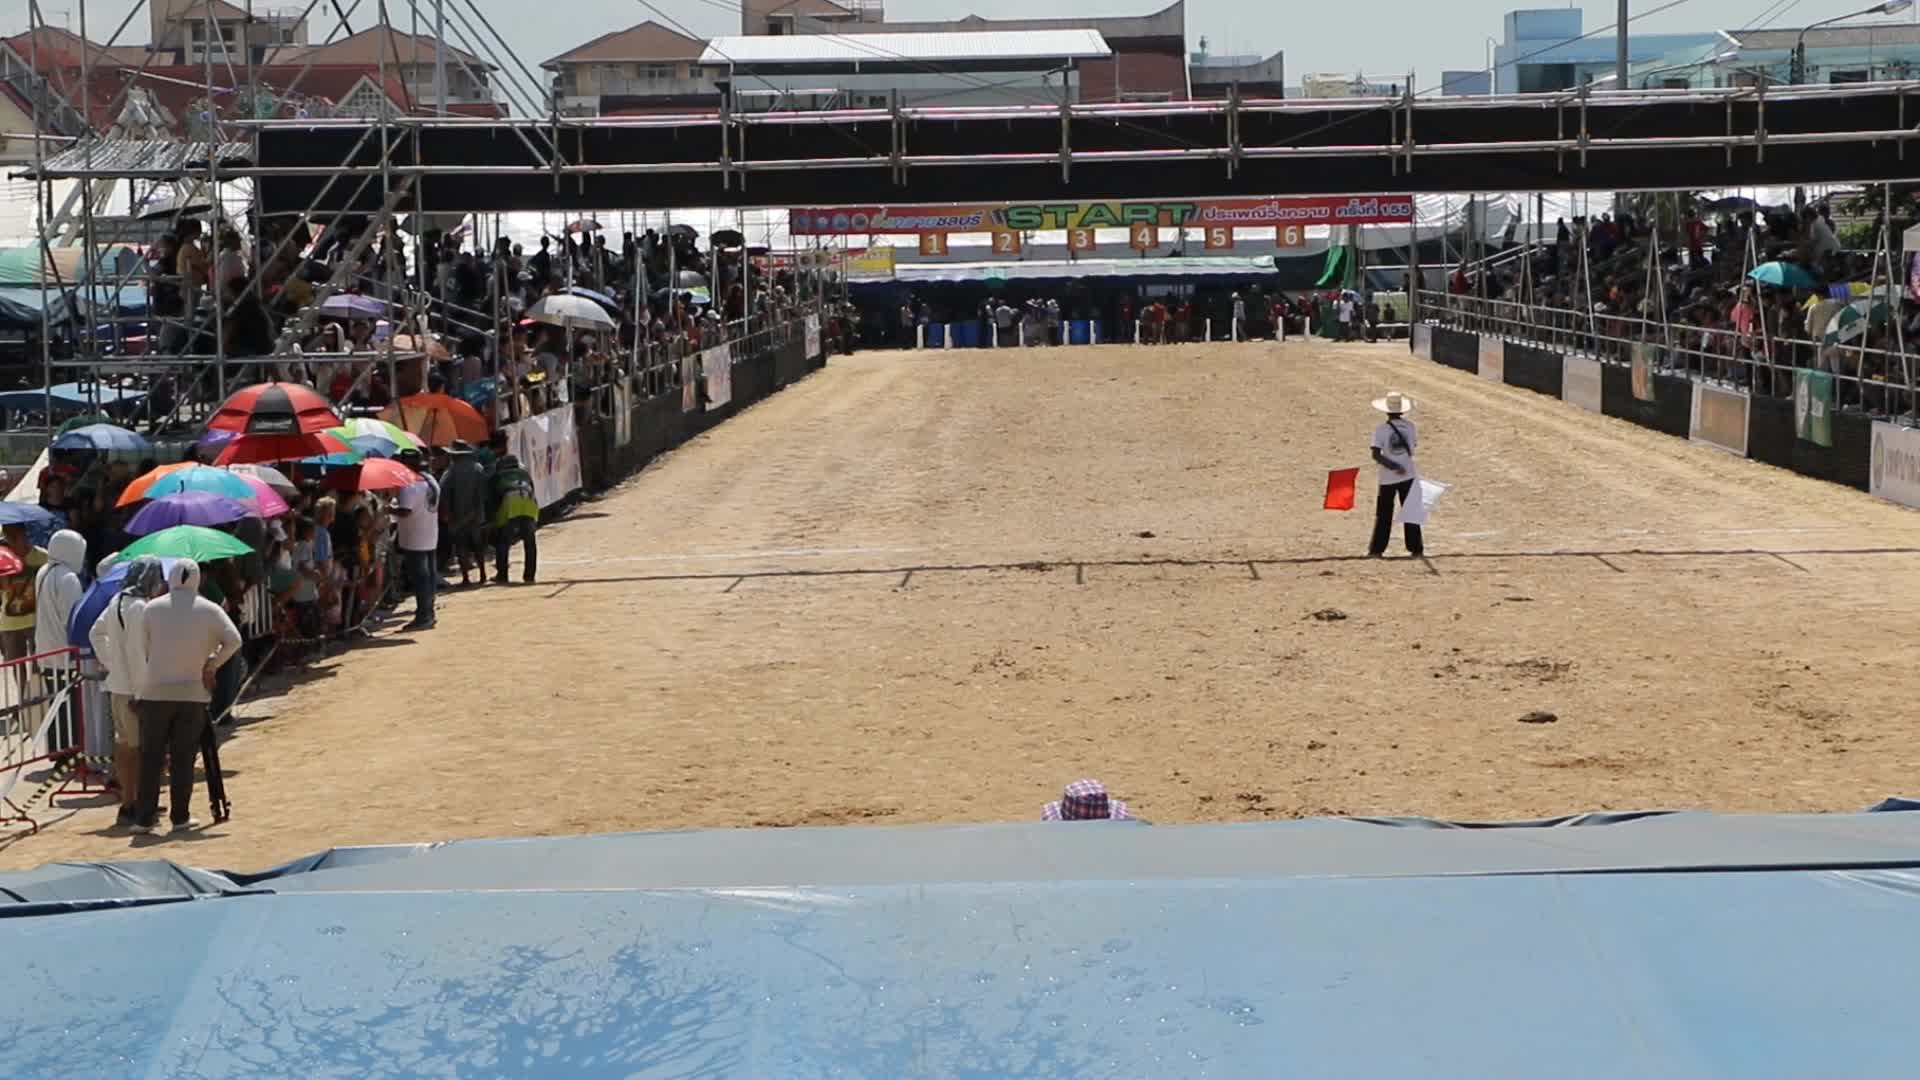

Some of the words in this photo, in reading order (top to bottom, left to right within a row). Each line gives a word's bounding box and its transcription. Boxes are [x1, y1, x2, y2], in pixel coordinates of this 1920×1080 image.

[1007, 203, 1195, 229] START
[1381, 203, 1411, 216] 155
[928, 234, 941, 254] 1
[1000, 234, 1012, 252] 2
[1075, 231, 1088, 248] 3
[1136, 227, 1150, 246] 4
[1213, 228, 1226, 246] 5
[1285, 226, 1298, 245] 6
